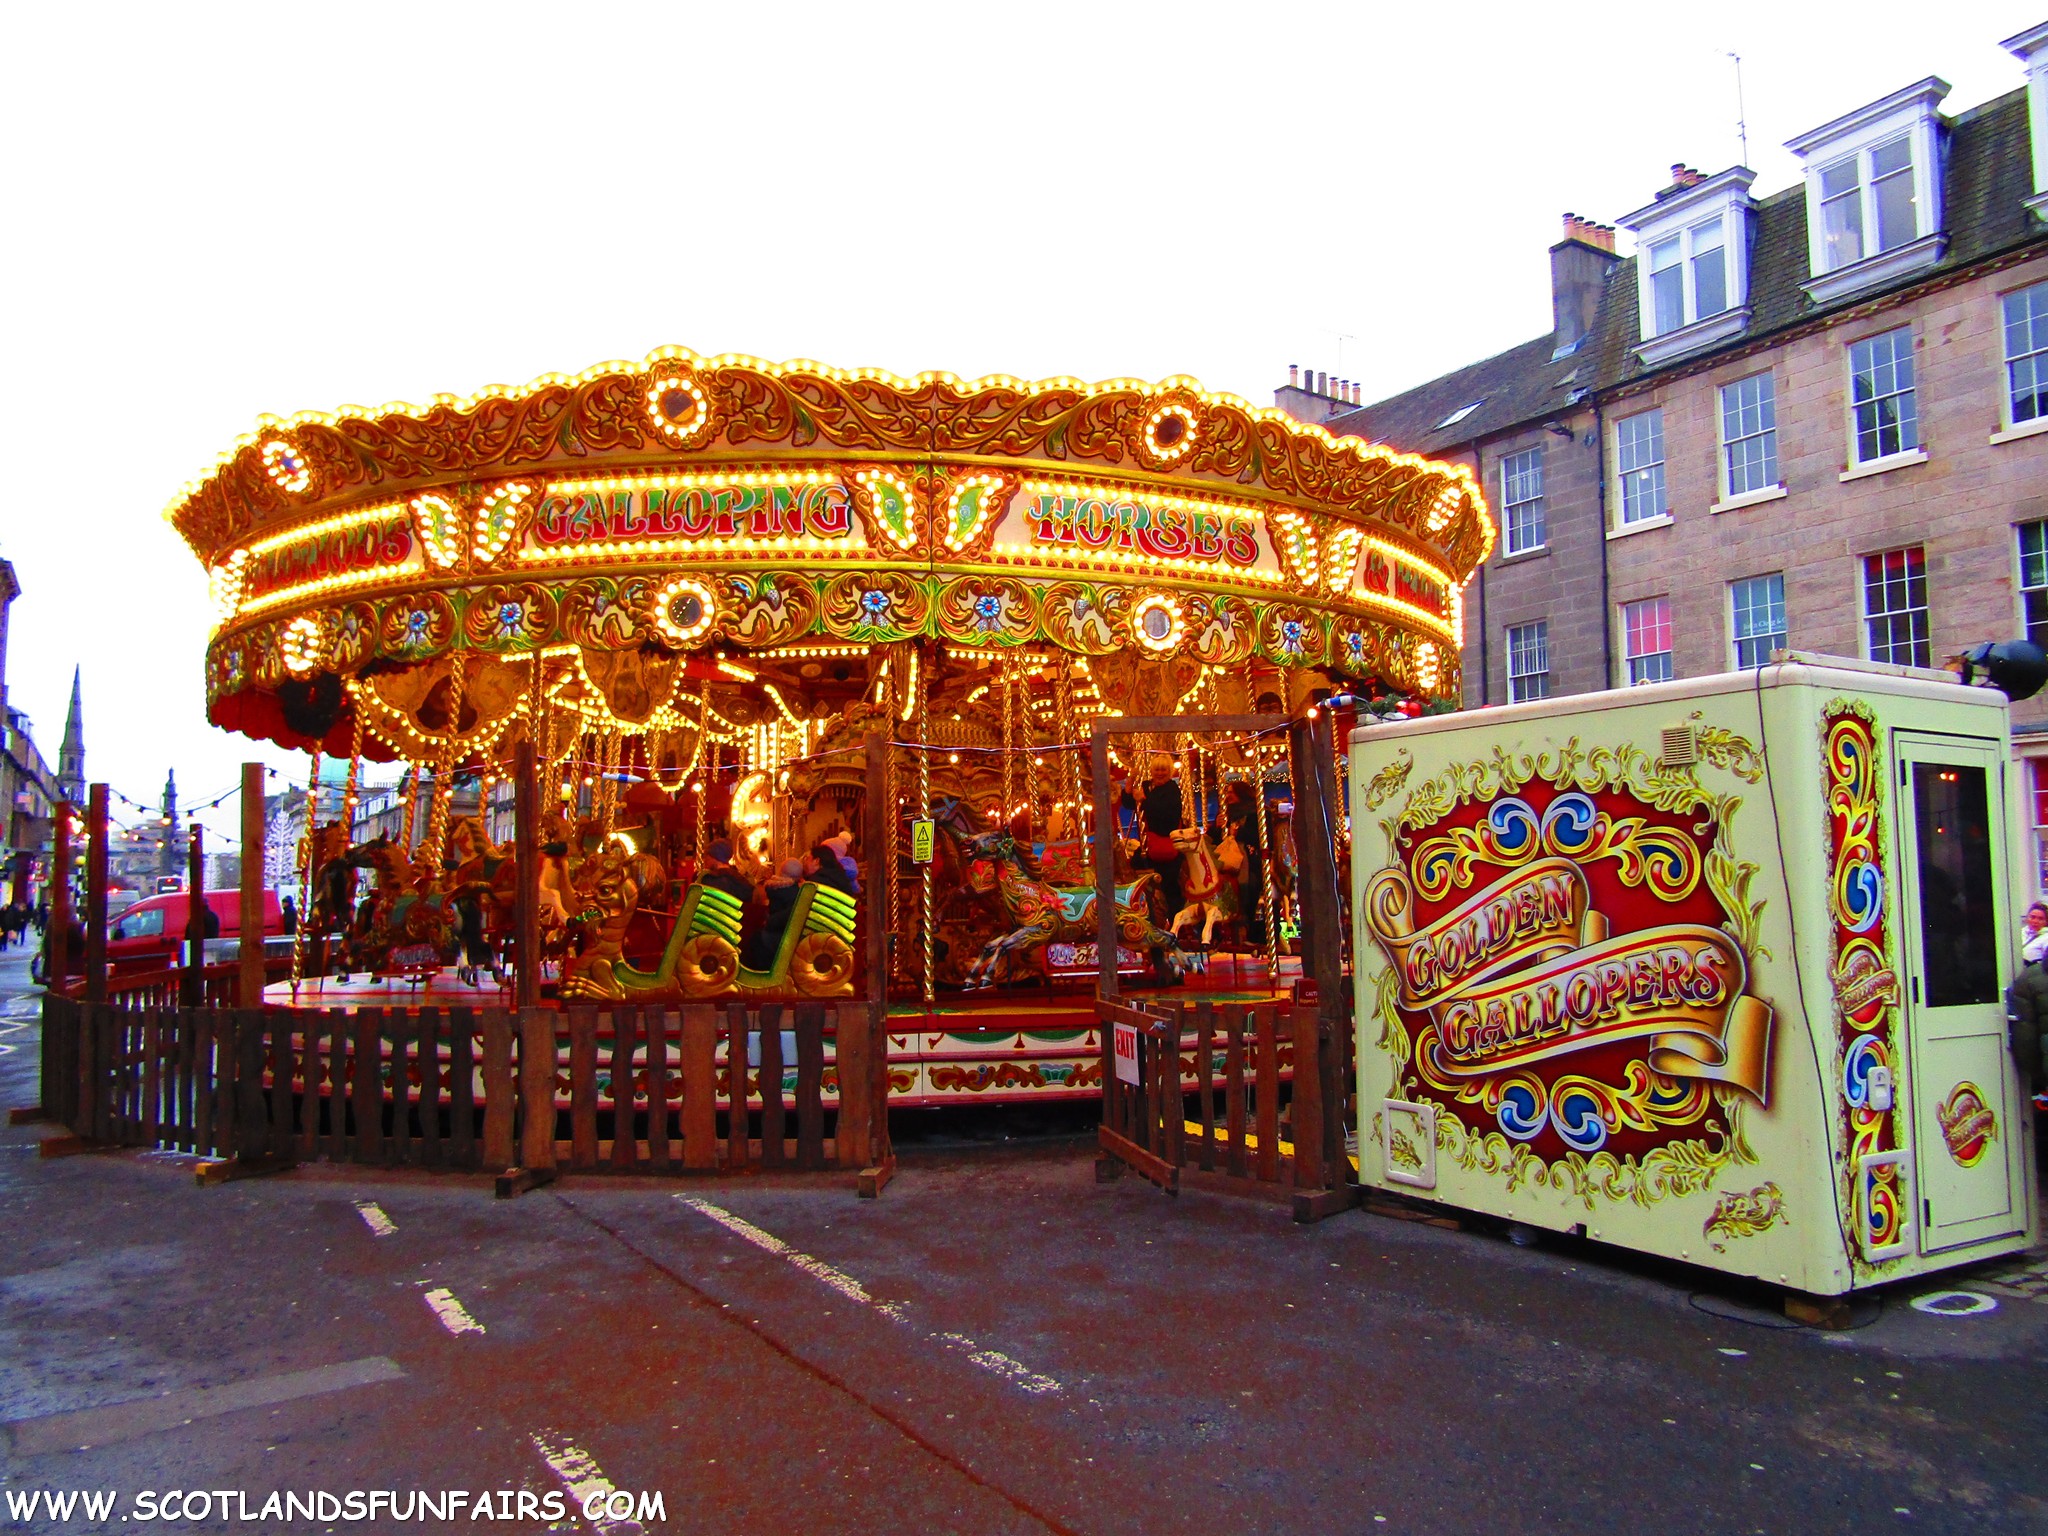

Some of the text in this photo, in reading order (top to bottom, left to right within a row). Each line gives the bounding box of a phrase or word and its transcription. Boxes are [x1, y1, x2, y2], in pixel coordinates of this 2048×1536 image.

[534, 483, 851, 546] GALLOPING
[1026, 495, 1260, 568] HORSES
[1405, 872, 1576, 997] GOLDEN
[1441, 945, 1727, 1061] GALLOPERS
[1115, 1028, 1135, 1060] EXIT
